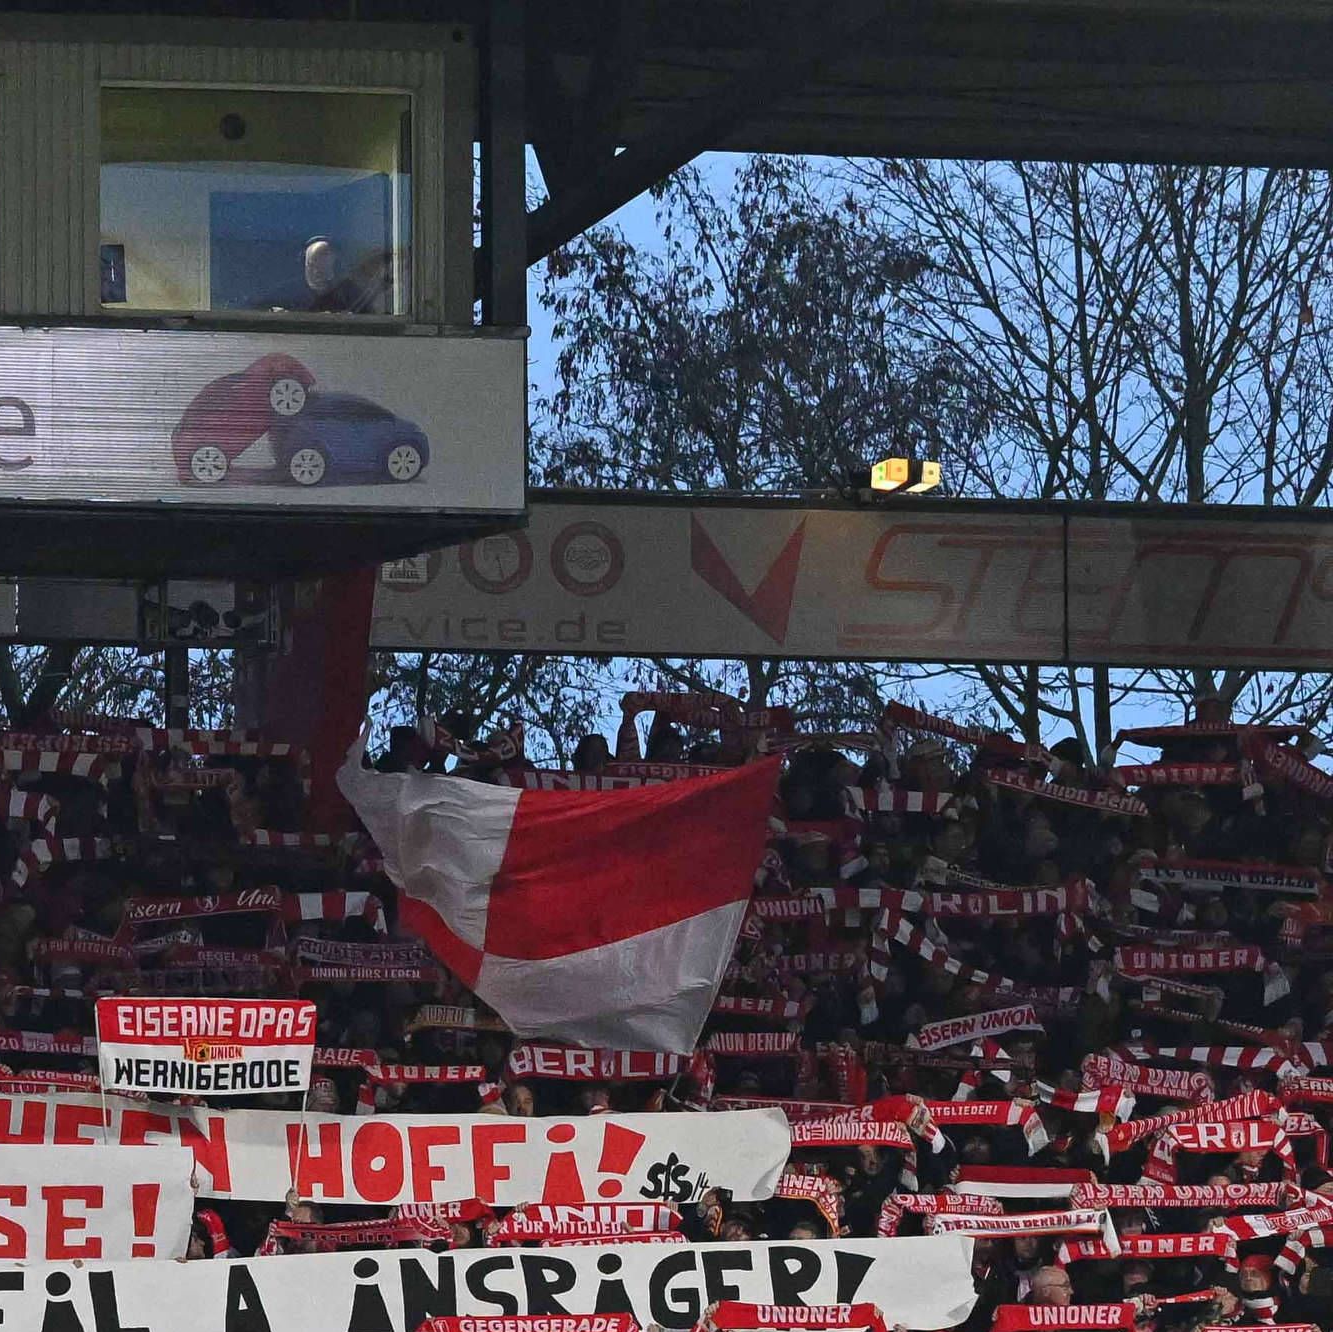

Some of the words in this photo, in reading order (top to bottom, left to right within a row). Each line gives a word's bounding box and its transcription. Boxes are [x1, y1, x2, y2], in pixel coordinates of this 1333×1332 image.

[1133, 950, 1247, 970] UNIONER
[117, 1006, 234, 1038] EISERNE
[239, 1003, 314, 1036] OPAS
[211, 1045, 243, 1060] UNION
[114, 1059, 300, 1090] WERNIGERODE
[758, 1305, 850, 1324] UNIONER
[1029, 1305, 1122, 1324] UNIONER
